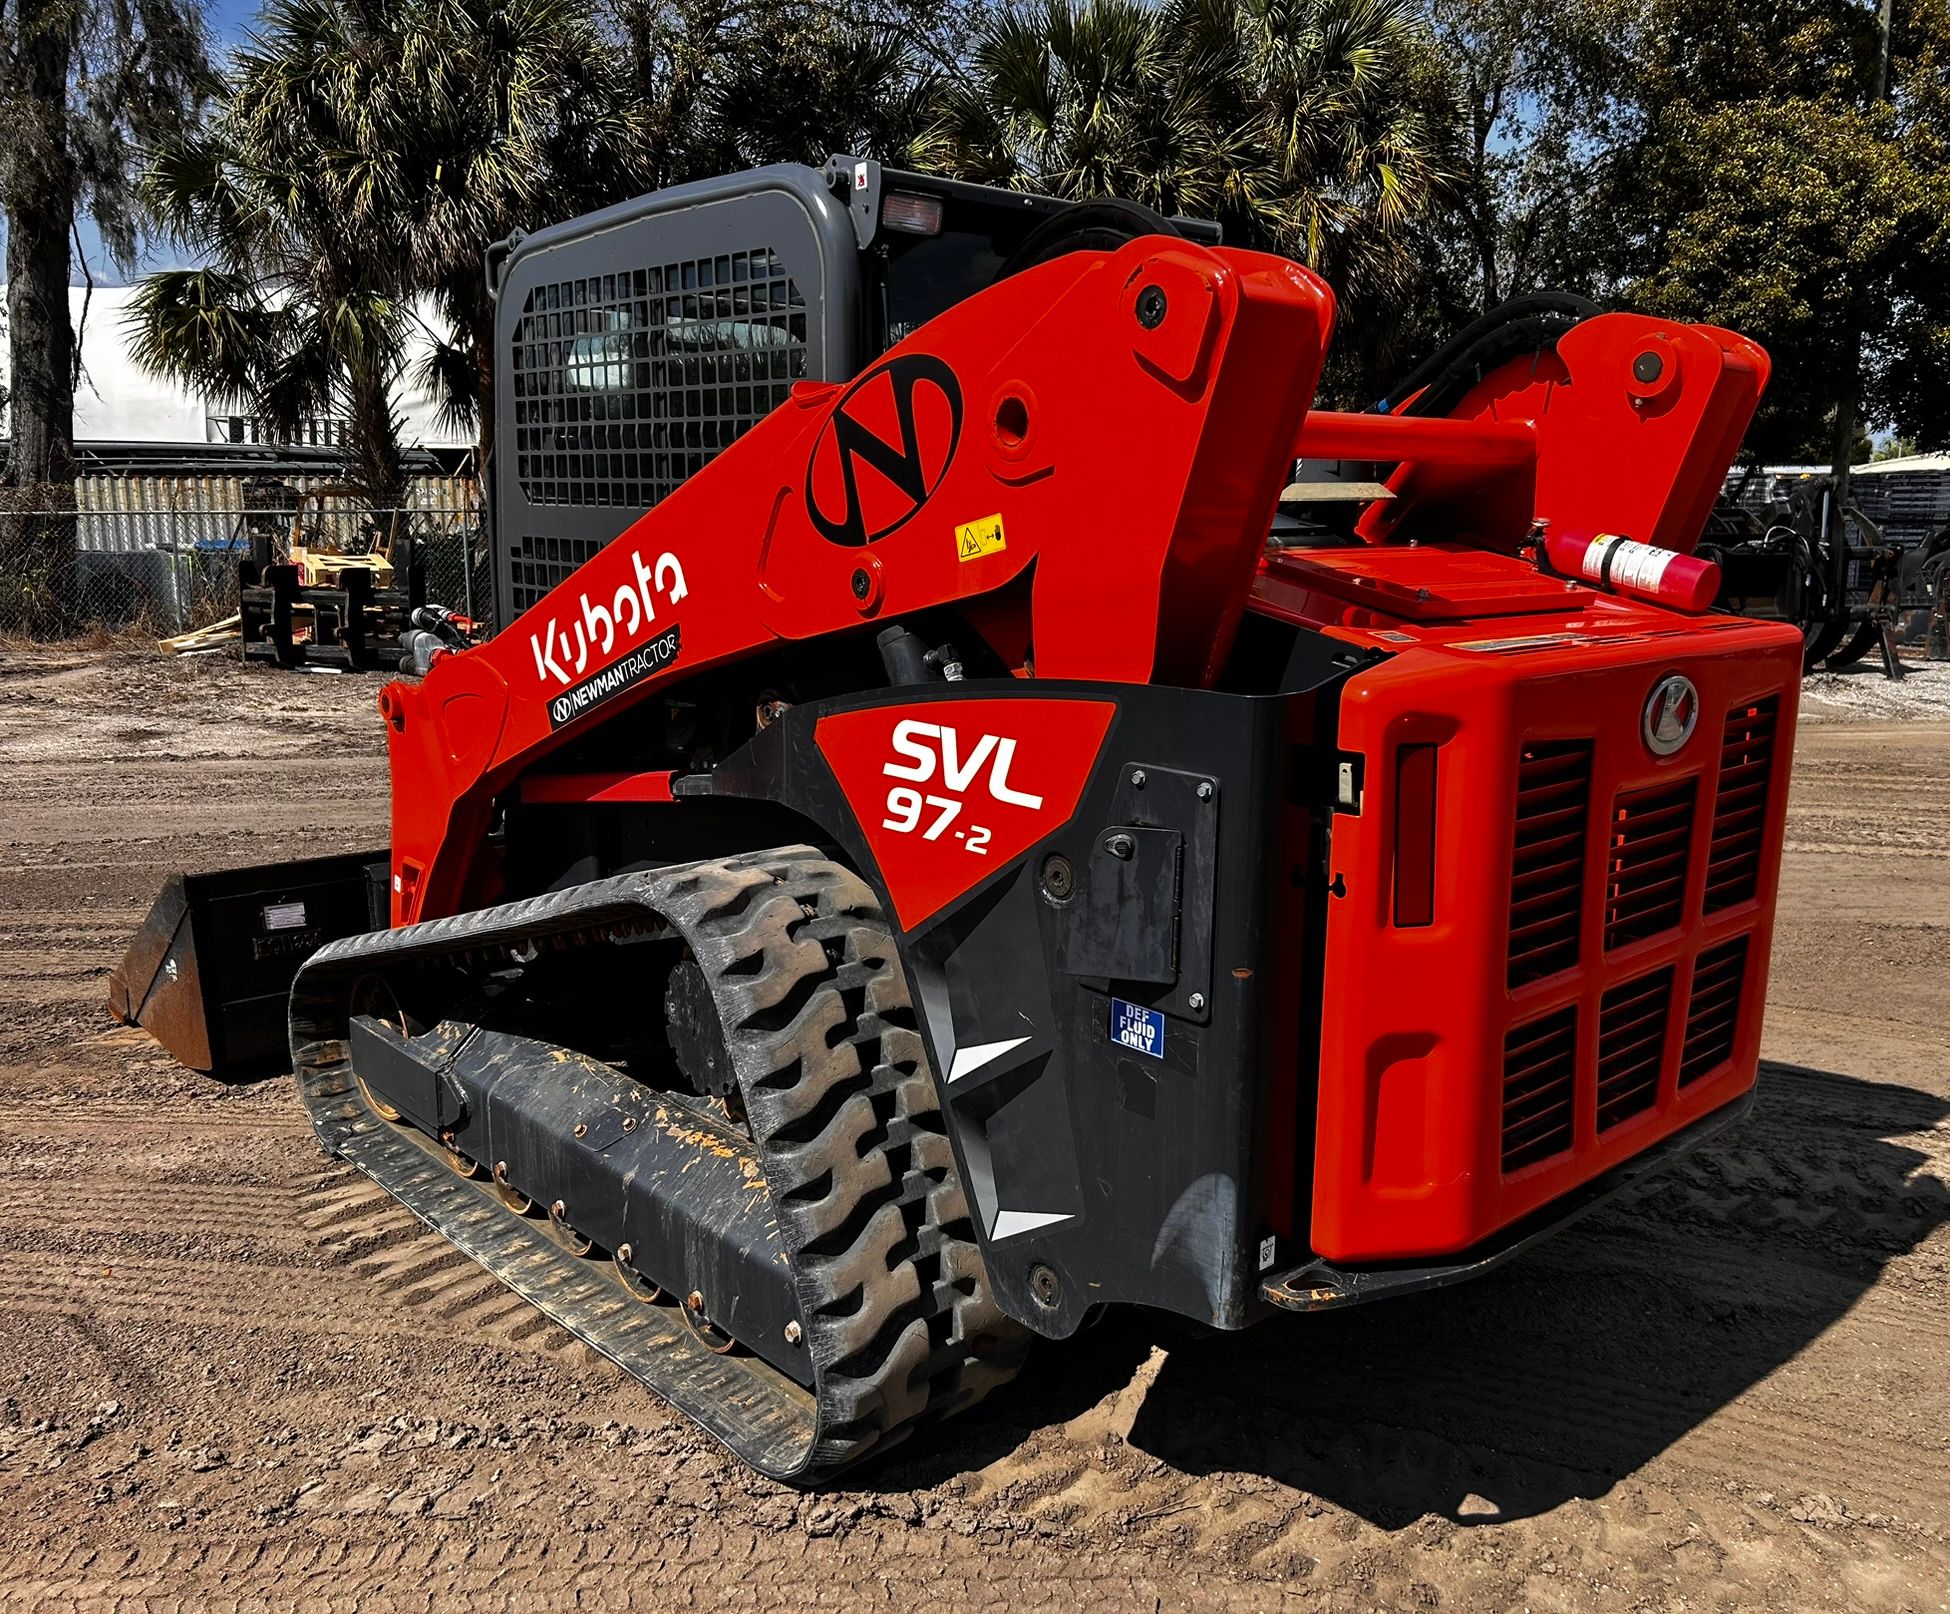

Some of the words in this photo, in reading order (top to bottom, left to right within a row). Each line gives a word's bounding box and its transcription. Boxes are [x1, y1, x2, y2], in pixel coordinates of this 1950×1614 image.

[530, 550, 689, 685] Kubota
[882, 719, 1044, 810] SVL
[882, 787, 992, 855] 97-2
[1120, 1015, 1155, 1039] FLUID
[1126, 1004, 1150, 1022] DEF
[1121, 1030, 1153, 1052] ONLY
